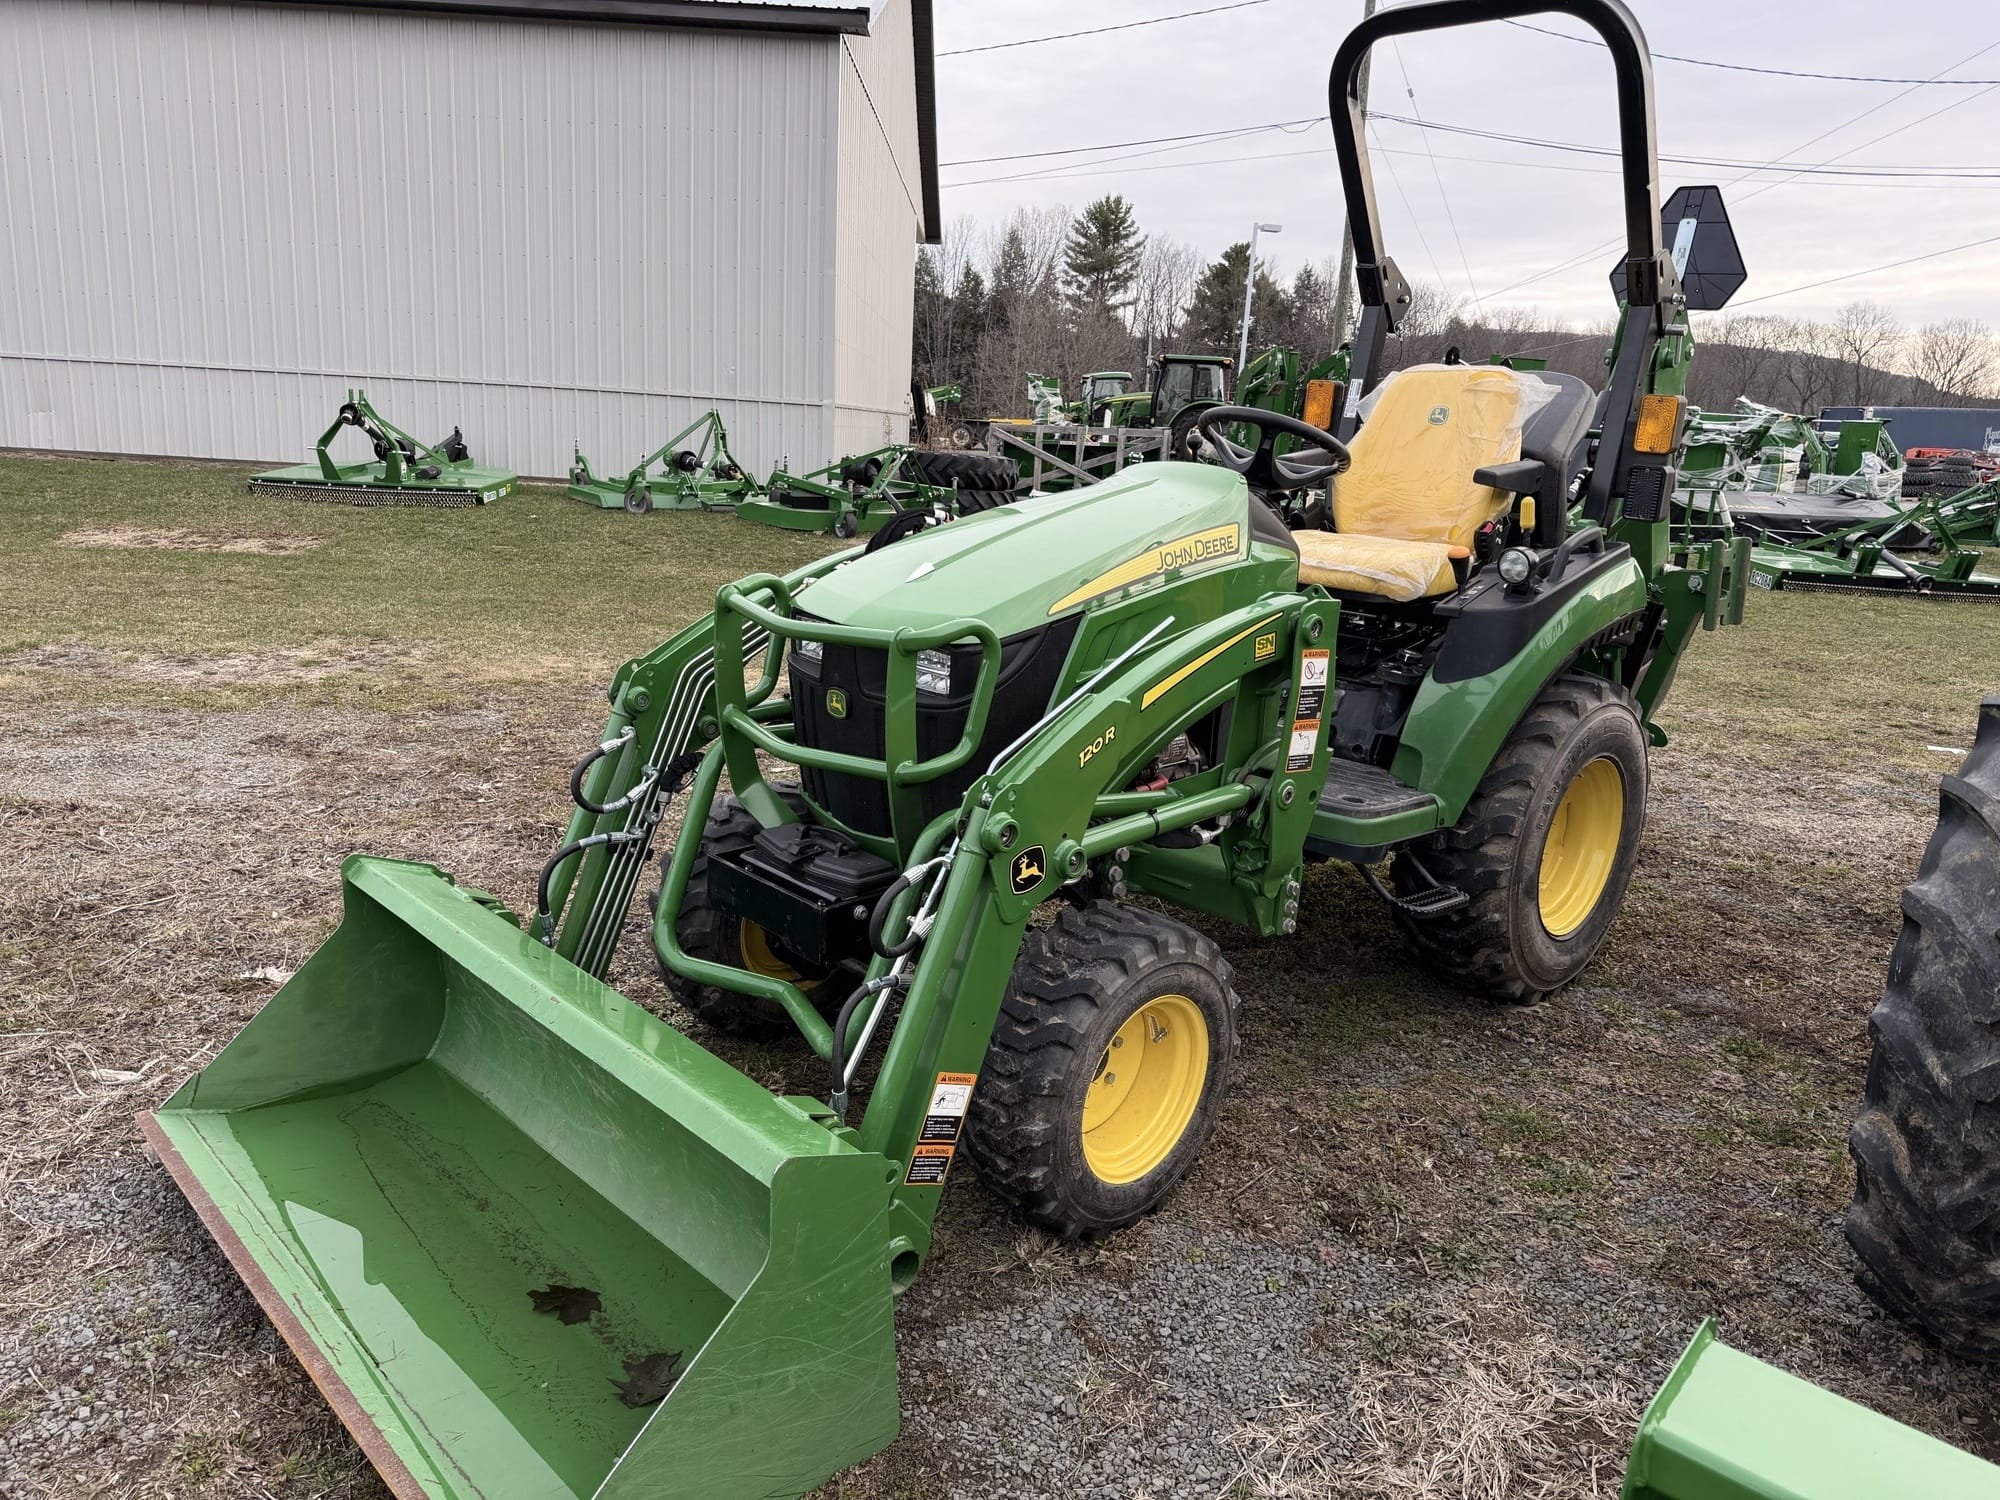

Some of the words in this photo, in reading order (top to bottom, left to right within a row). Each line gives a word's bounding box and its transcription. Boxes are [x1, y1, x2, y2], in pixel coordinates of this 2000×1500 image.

[1157, 543, 1193, 571] JOHN
[1194, 535, 1234, 559] DEERE
[1105, 726, 1115, 745] R
[1299, 723, 1319, 731] WARNING
